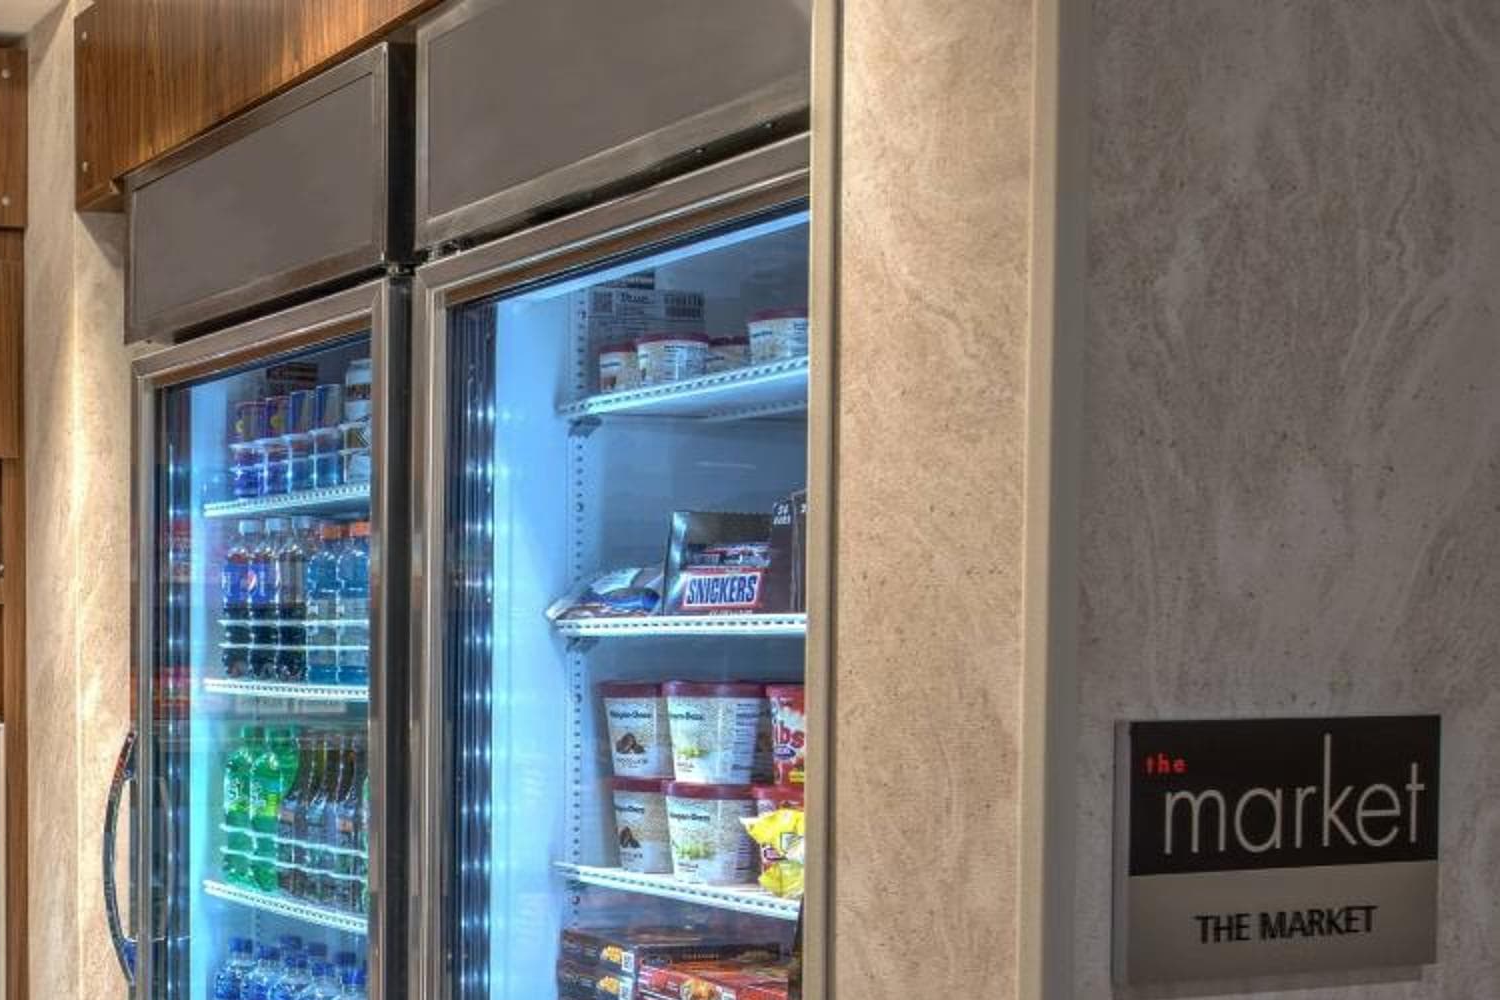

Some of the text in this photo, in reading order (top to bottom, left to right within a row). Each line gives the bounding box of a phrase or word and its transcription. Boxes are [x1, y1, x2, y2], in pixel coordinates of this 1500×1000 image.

[687, 575, 757, 604] SNICKERS
[1144, 753, 1187, 774] the
[1164, 733, 1426, 855] market
[1195, 904, 1378, 944] THE MARKET
